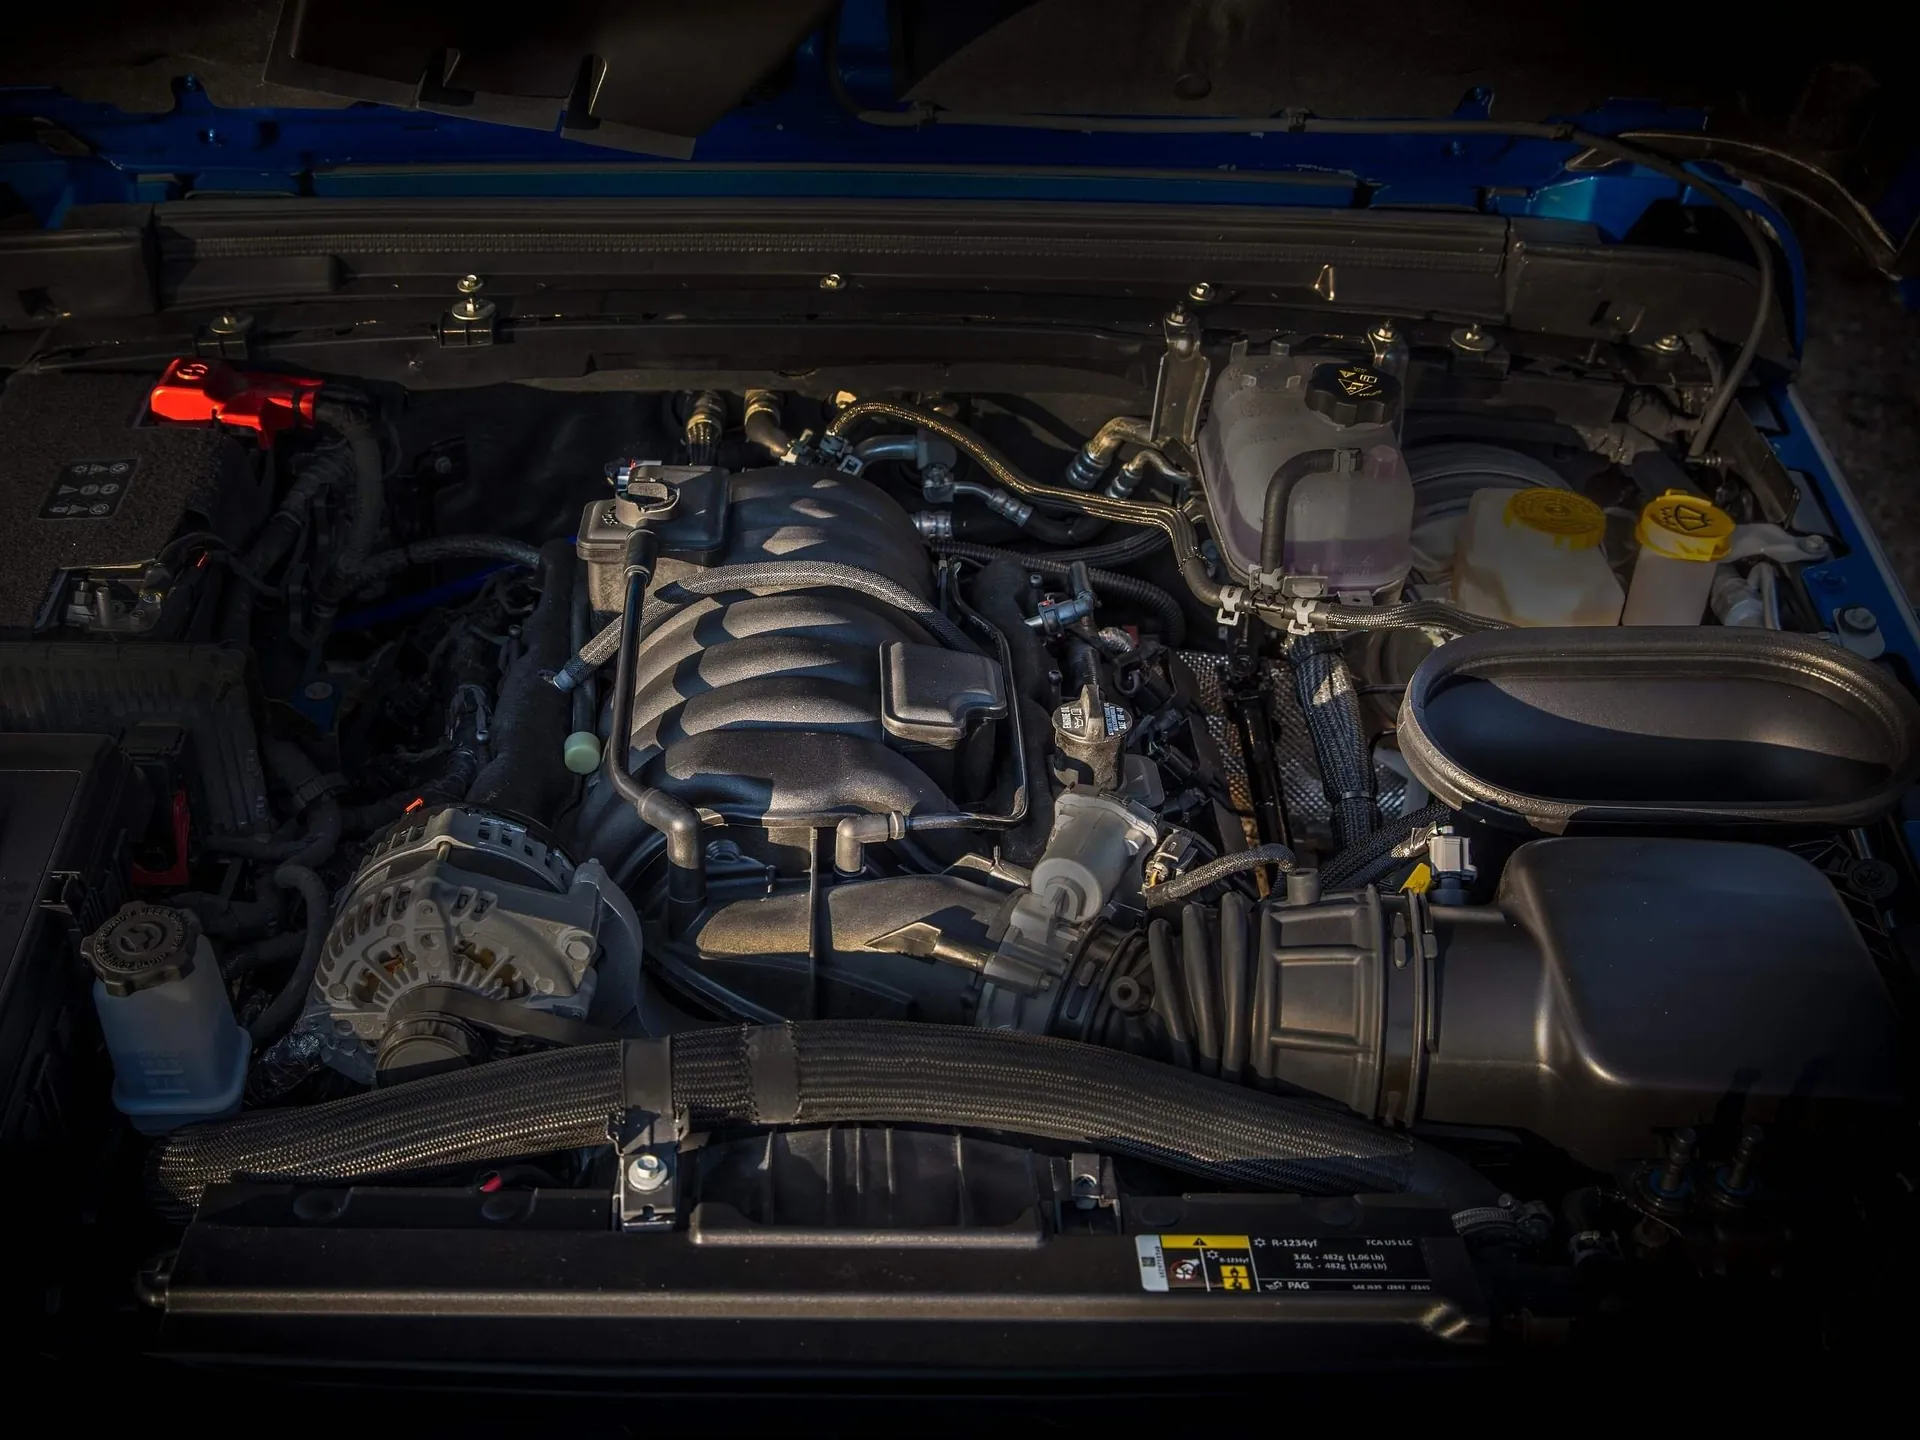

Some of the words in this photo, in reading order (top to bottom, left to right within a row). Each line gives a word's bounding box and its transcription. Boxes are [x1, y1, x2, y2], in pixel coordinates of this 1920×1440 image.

[1271, 1239, 1318, 1249] R-1234yf
[1366, 1239, 1384, 1247] FCA
[1384, 1239, 1397, 1247] US
[1398, 1239, 1413, 1247] LLC
[1293, 1253, 1312, 1261] 3.6L
[1322, 1253, 1345, 1262] 482g
[1295, 1262, 1315, 1270] 2.0L
[1324, 1262, 1347, 1271] 482g
[1287, 1281, 1311, 1290] PAG
